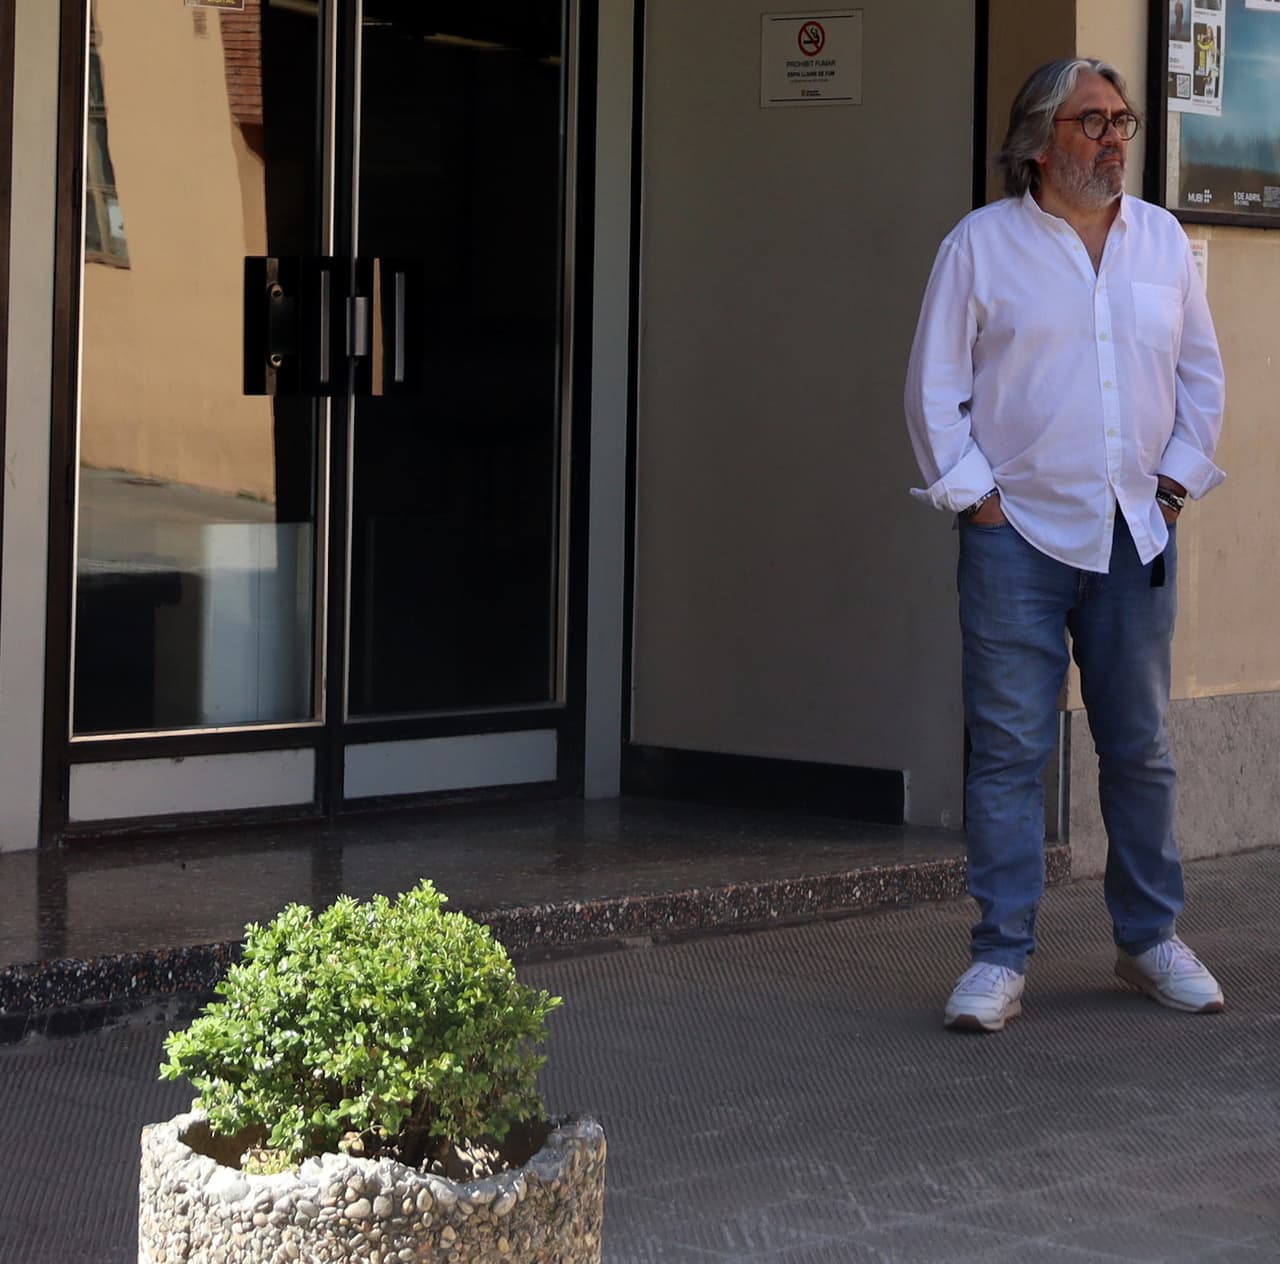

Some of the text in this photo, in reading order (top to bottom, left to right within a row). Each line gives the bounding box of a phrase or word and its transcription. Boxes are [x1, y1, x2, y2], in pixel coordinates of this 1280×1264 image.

[814, 59, 836, 67] FUMAR
[1188, 191, 1204, 204] MUBI
[1237, 192, 1247, 201] DE
[1247, 192, 1262, 203] ABRIL
